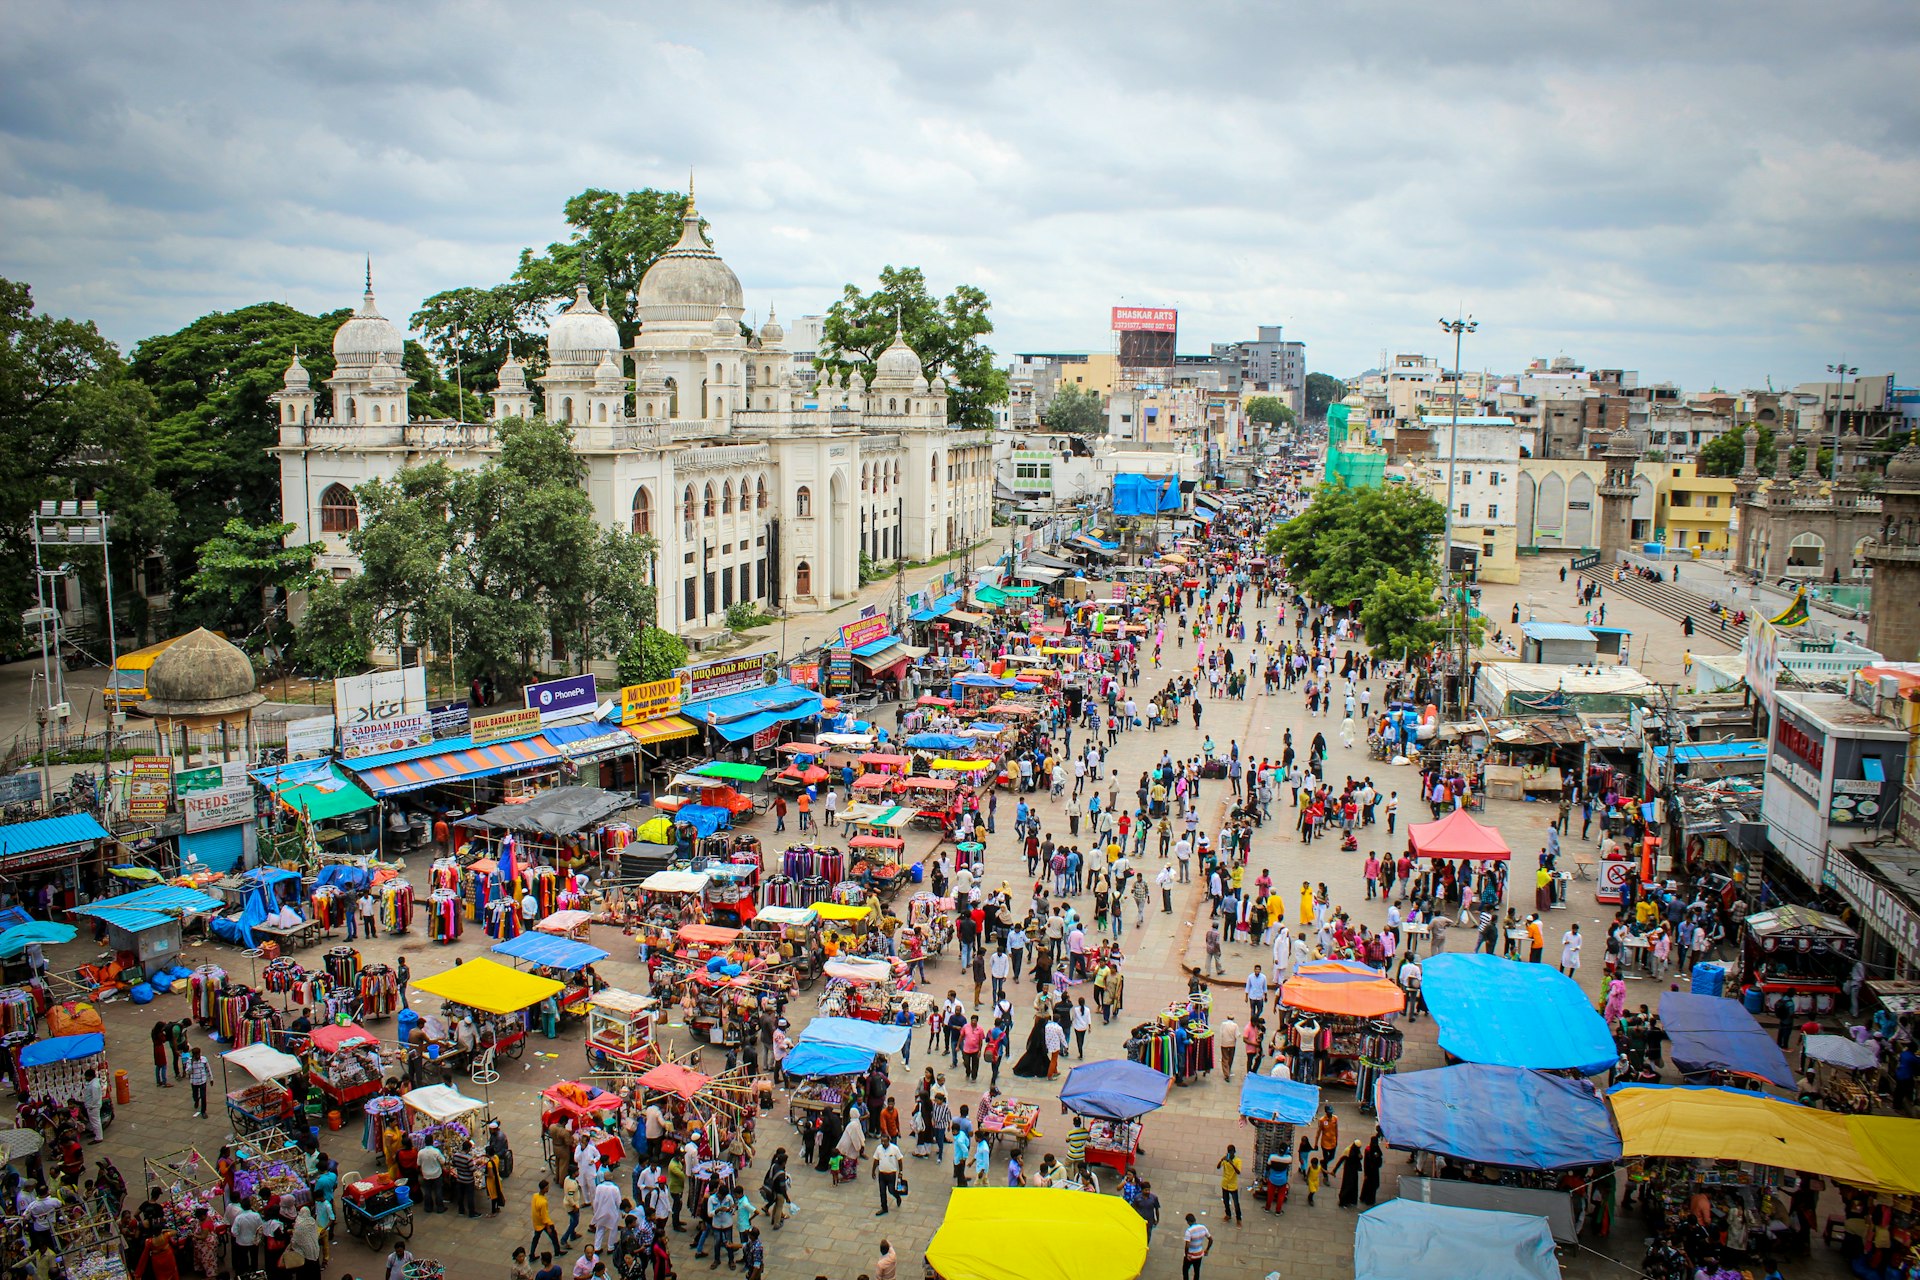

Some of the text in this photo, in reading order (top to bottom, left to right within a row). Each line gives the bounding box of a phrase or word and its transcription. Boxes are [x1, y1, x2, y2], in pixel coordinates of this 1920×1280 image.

[1117, 310, 1174, 320] BHASKAR ARTS
[693, 664, 736, 680] MUQADDAR
[737, 659, 762, 671] HOTEL
[555, 688, 585, 700] PhonePe
[628, 681, 676, 702] MUNNU
[651, 697, 669, 706] SHOP
[352, 723, 390, 736] SADDAM
[393, 717, 423, 729] HOTEL
[474, 711, 539, 729] ABUL BARKAAT BAKERY
[512, 761, 532, 769] BARKAAT
[533, 758, 549, 766] BAKERY
[1845, 781, 1879, 789] NIMRAH
[189, 790, 251, 813] NEEDS GENERAL
[207, 808, 222, 816] COOL
[1822, 870, 1836, 886] VEG
[1876, 889, 1908, 937] CAFE
[1908, 921, 1919, 949] &
[1861, 905, 1913, 961] IRANI CHAI
